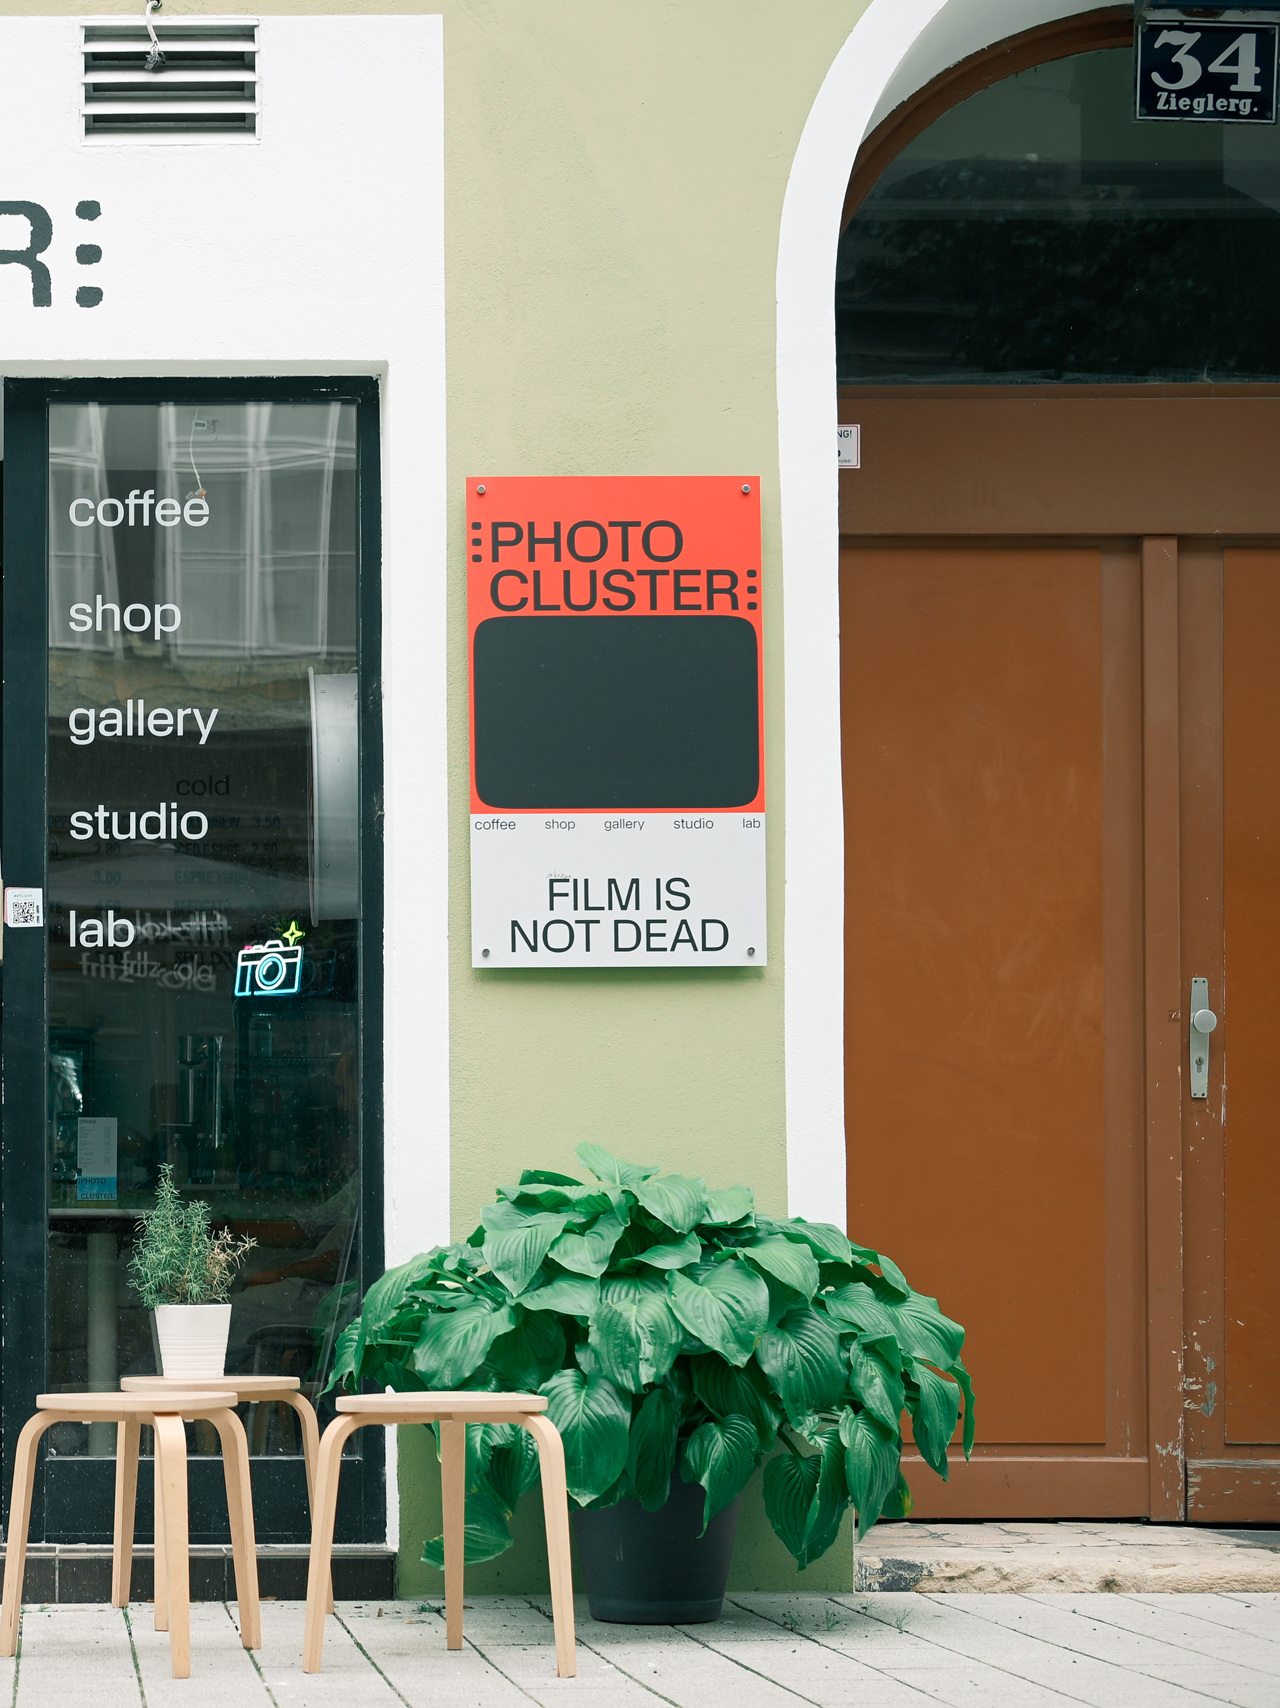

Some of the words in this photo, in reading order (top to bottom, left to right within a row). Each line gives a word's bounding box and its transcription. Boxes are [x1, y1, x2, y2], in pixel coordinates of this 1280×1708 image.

[1151, 30, 1261, 92] 34
[1157, 92, 1258, 115] Zieglerg.
[69, 489, 210, 527] coffee
[492, 520, 683, 563] PHOTO
[490, 569, 739, 611] CLUSTER
[69, 595, 181, 640] shop
[69, 699, 219, 745] gallery
[175, 774, 230, 796] cold
[69, 802, 208, 839] studio
[474, 818, 517, 831] coffee
[544, 818, 576, 832] shop
[604, 818, 645, 832] gallery
[673, 817, 714, 830] studio
[742, 817, 761, 829] lab
[549, 878, 639, 911] FILM
[656, 878, 690, 911] IS
[69, 910, 135, 947] lab
[511, 919, 600, 953] NOT
[614, 919, 728, 952] DEAD
[81, 1177, 107, 1185] PHOTO
[81, 1192, 114, 1200] CLUSTER
